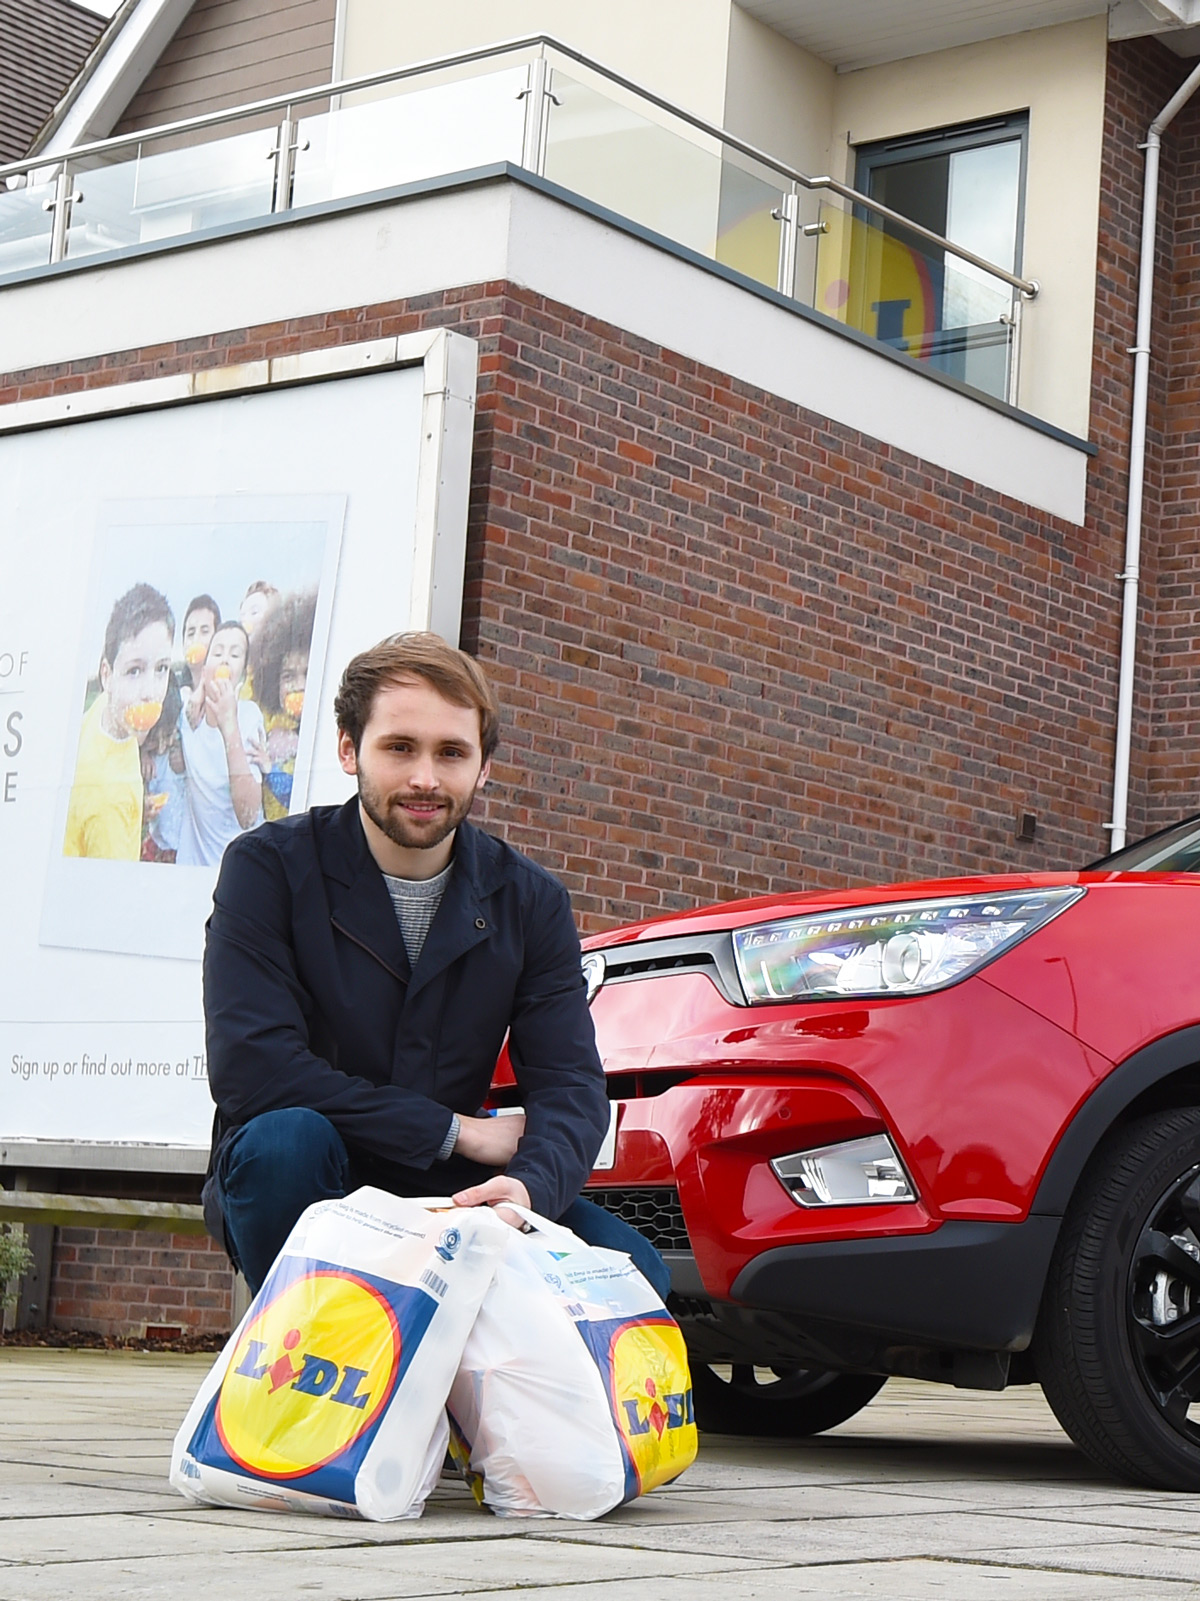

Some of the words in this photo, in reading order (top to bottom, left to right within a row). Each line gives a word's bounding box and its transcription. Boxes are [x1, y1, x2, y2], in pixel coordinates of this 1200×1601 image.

[3, 711, 23, 757] S
[4, 772, 18, 802] E
[11, 1055, 38, 1081] Sign
[43, 1063, 59, 1081] up
[63, 1062, 78, 1075] or
[81, 1053, 107, 1076] find
[111, 1058, 132, 1076] out
[136, 1063, 171, 1076] more
[175, 1058, 190, 1076] at
[192, 1055, 208, 1077] Th
